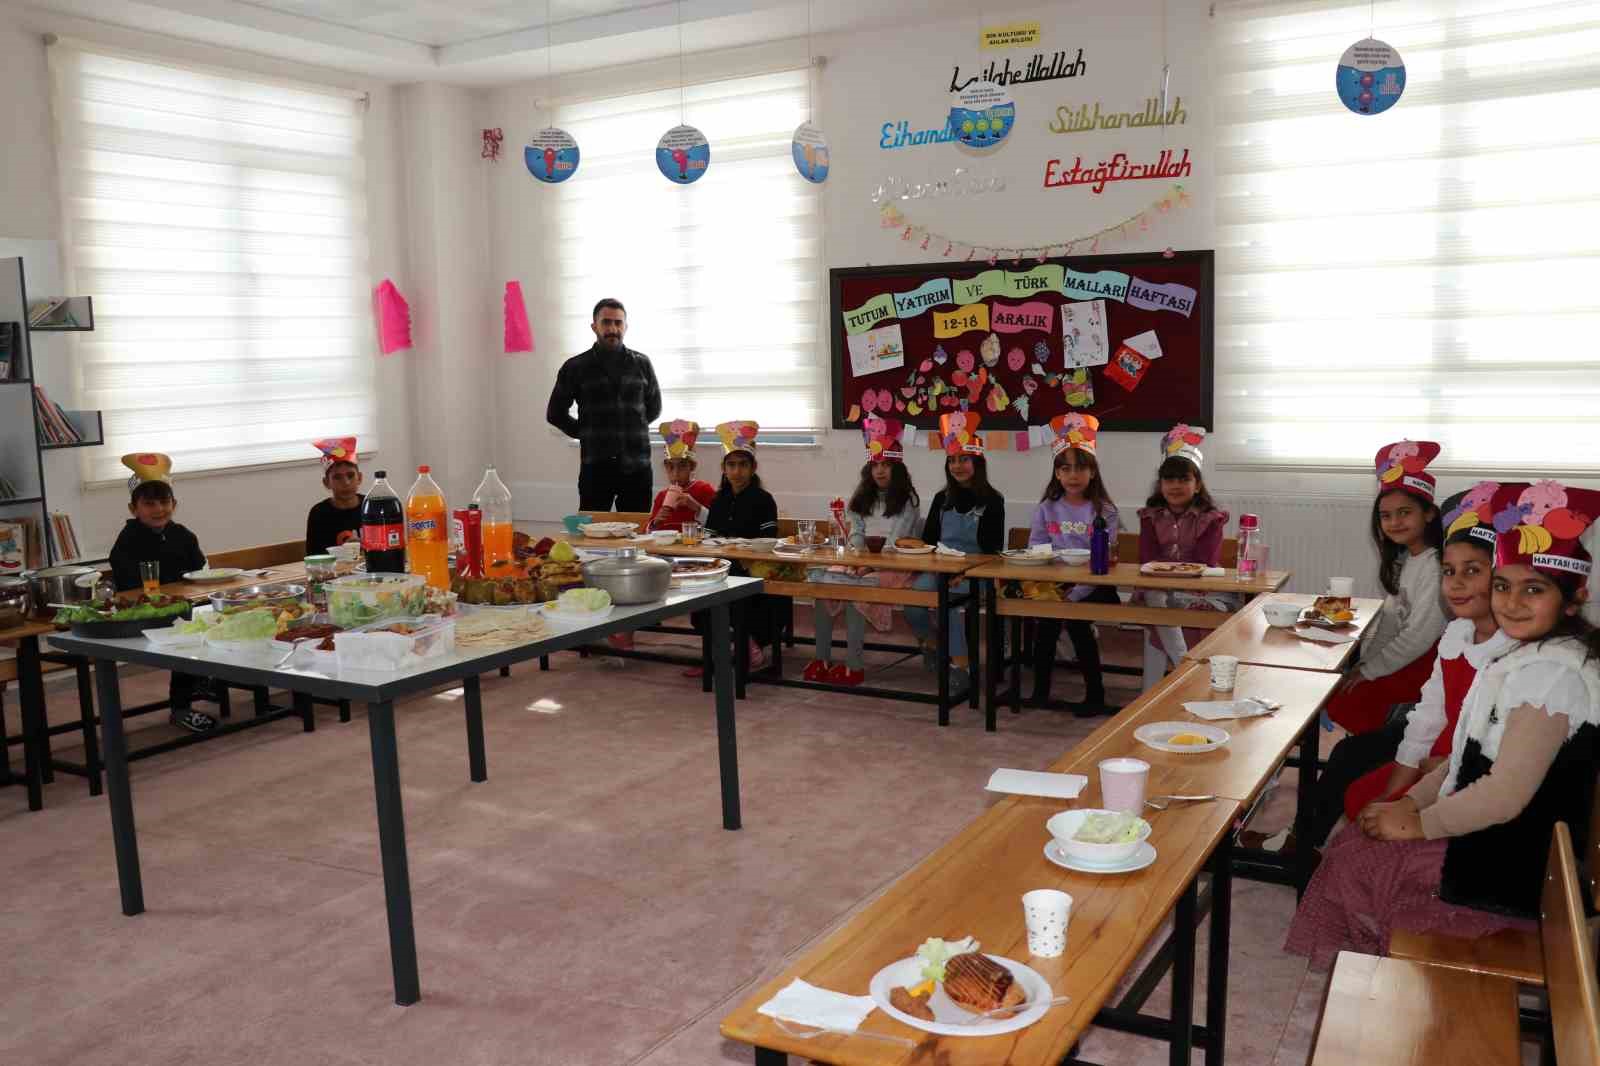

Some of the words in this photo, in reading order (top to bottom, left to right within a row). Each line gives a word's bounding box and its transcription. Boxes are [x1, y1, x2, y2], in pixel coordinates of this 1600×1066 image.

[1044, 149, 1192, 194] Estağfirullah
[848, 306, 889, 328] TUTUM
[895, 289, 950, 312] YATIRIM
[964, 284, 984, 297] VE
[1014, 275, 1049, 290] TÜRK
[1064, 276, 1126, 298] MALLARI
[1129, 285, 1192, 312] HAFTASI
[943, 314, 979, 330] 12-18
[994, 312, 1048, 329] ARALIK
[1534, 555, 1570, 569] HAFTASI
